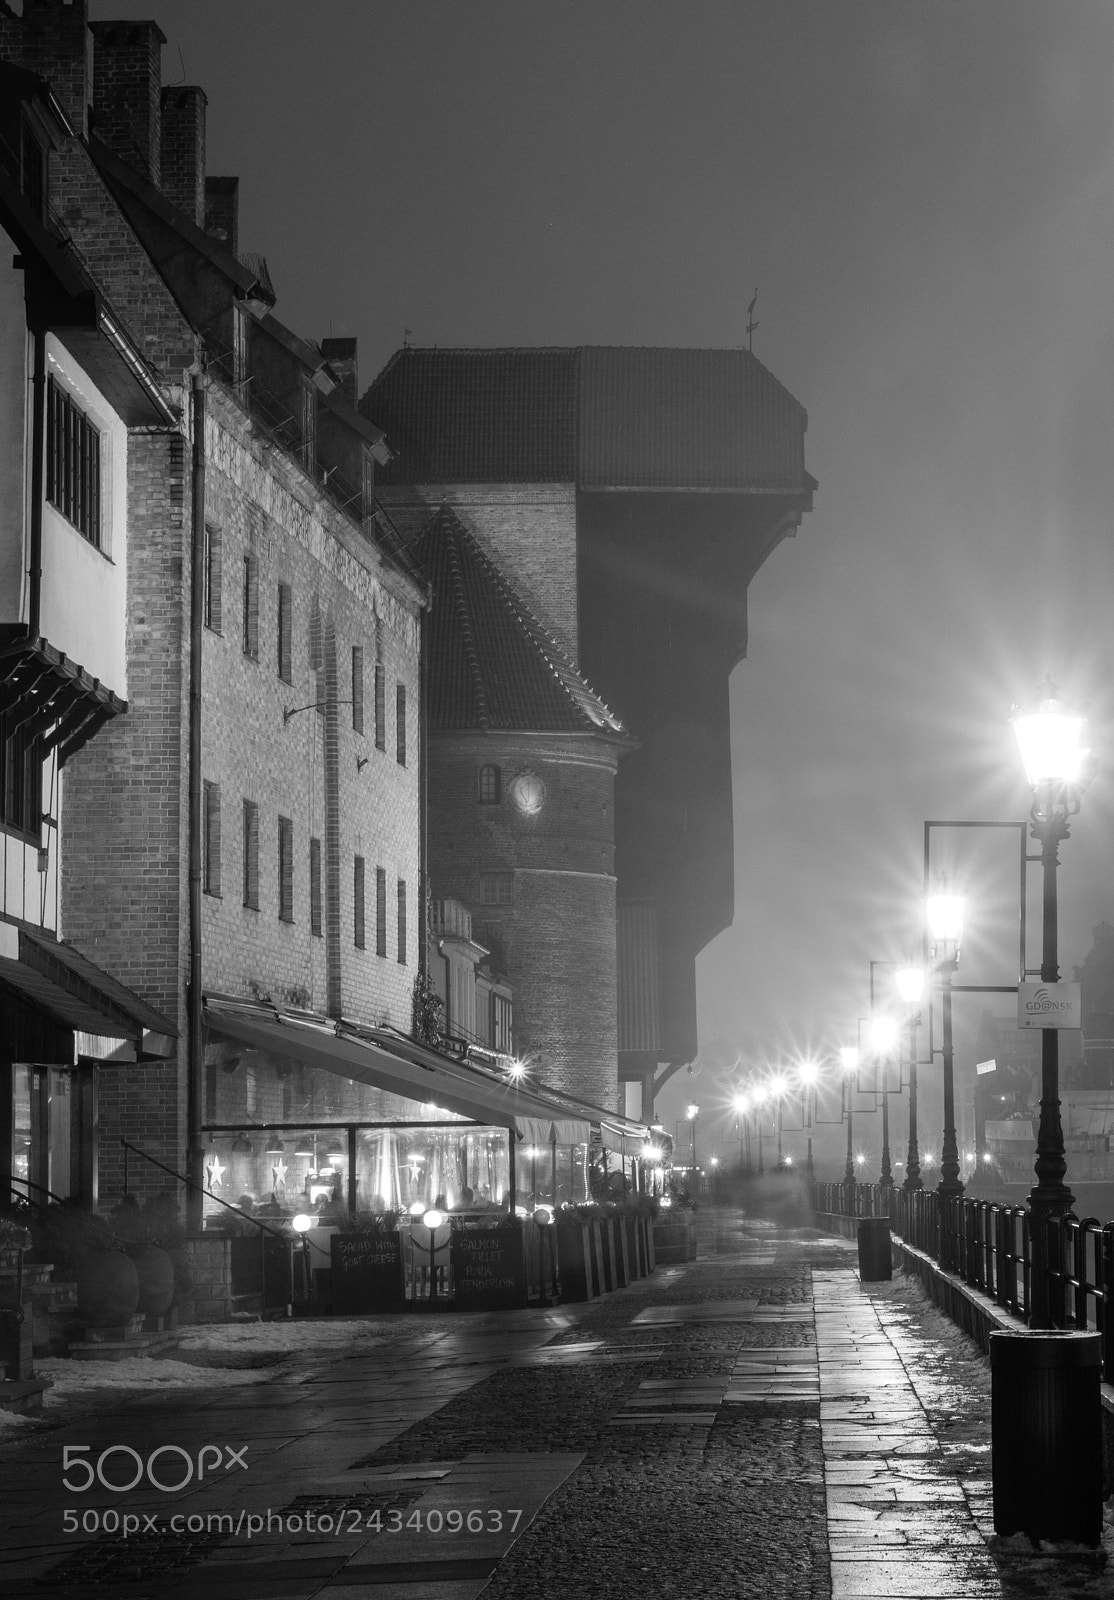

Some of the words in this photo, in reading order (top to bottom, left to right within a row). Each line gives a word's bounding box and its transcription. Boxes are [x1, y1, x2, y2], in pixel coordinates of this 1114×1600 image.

[338, 1240, 371, 1253] SALAD
[459, 1237, 499, 1251] SALMON
[341, 1255, 365, 1272] GOAT
[366, 1252, 397, 1265] CHEESE
